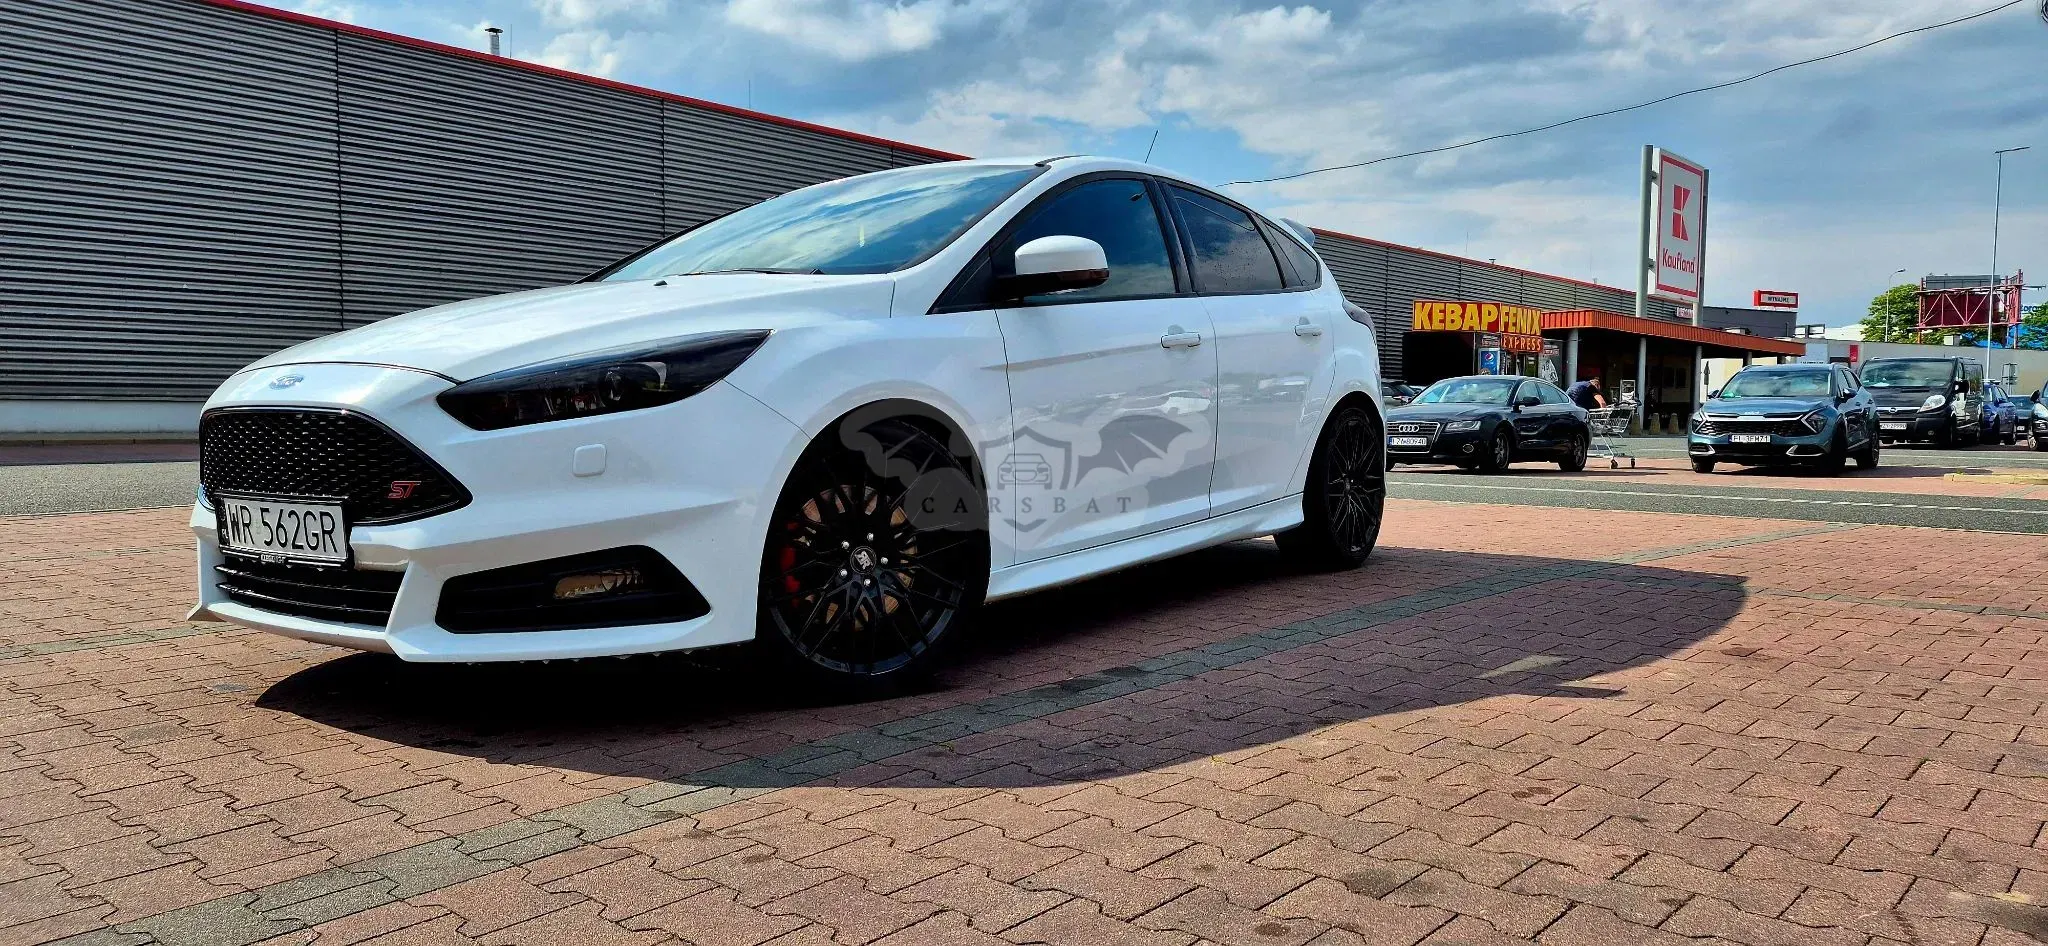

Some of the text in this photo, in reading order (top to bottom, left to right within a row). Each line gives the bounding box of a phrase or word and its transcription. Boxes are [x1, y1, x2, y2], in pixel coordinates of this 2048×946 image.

[1662, 247, 1696, 274] Kaufland
[1414, 302, 1541, 336] KEBAP FENIX
[1502, 336, 1541, 351] EXPRESS
[388, 480, 421, 499] ST
[226, 503, 338, 553] WR 562GR
